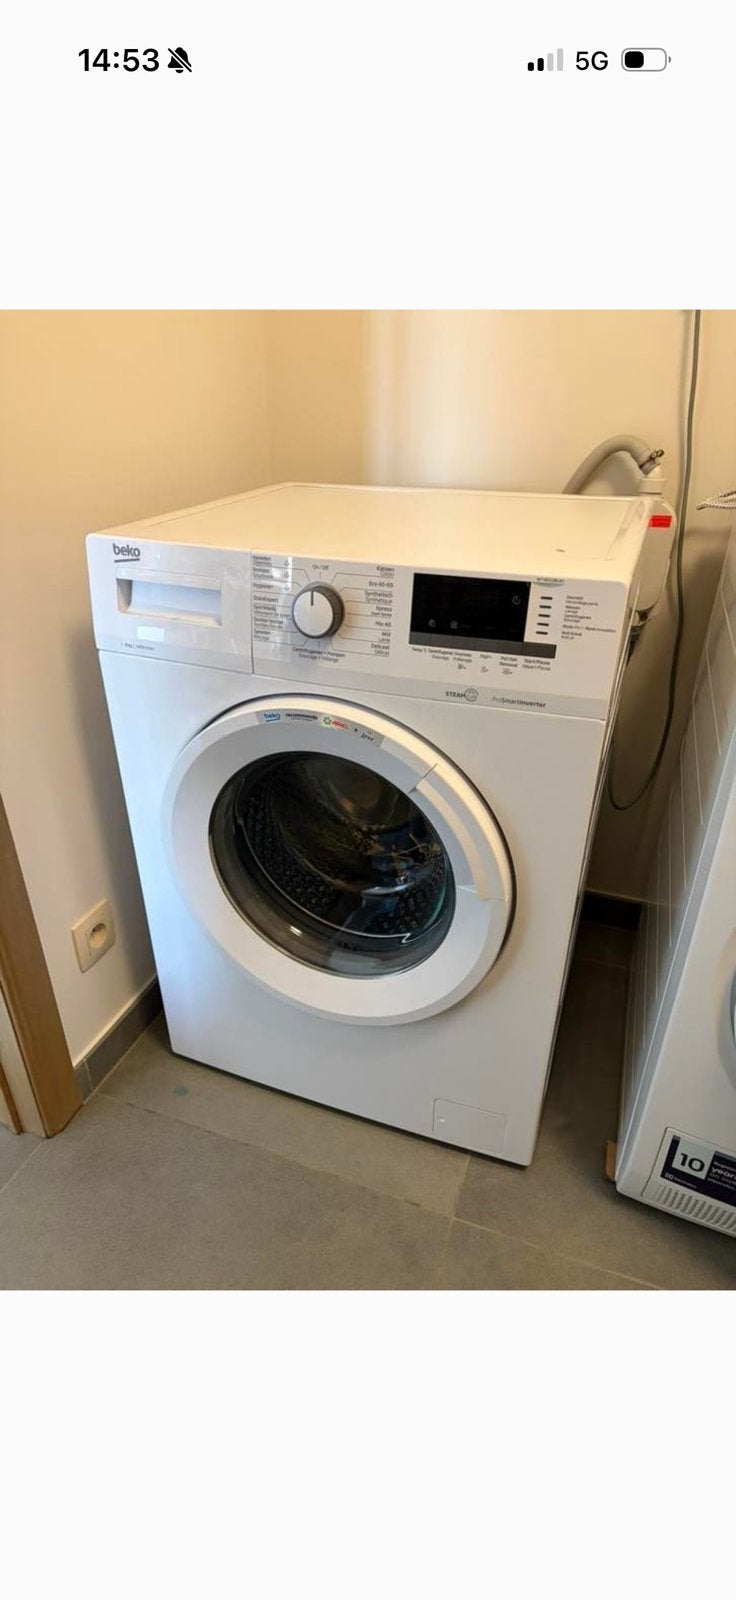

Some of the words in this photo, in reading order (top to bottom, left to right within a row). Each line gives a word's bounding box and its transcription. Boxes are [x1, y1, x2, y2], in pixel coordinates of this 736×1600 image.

[112, 543, 141, 557] beko
[445, 690, 466, 699] STEAM
[680, 1152, 705, 1172] 10
[711, 1167, 736, 1181] year
